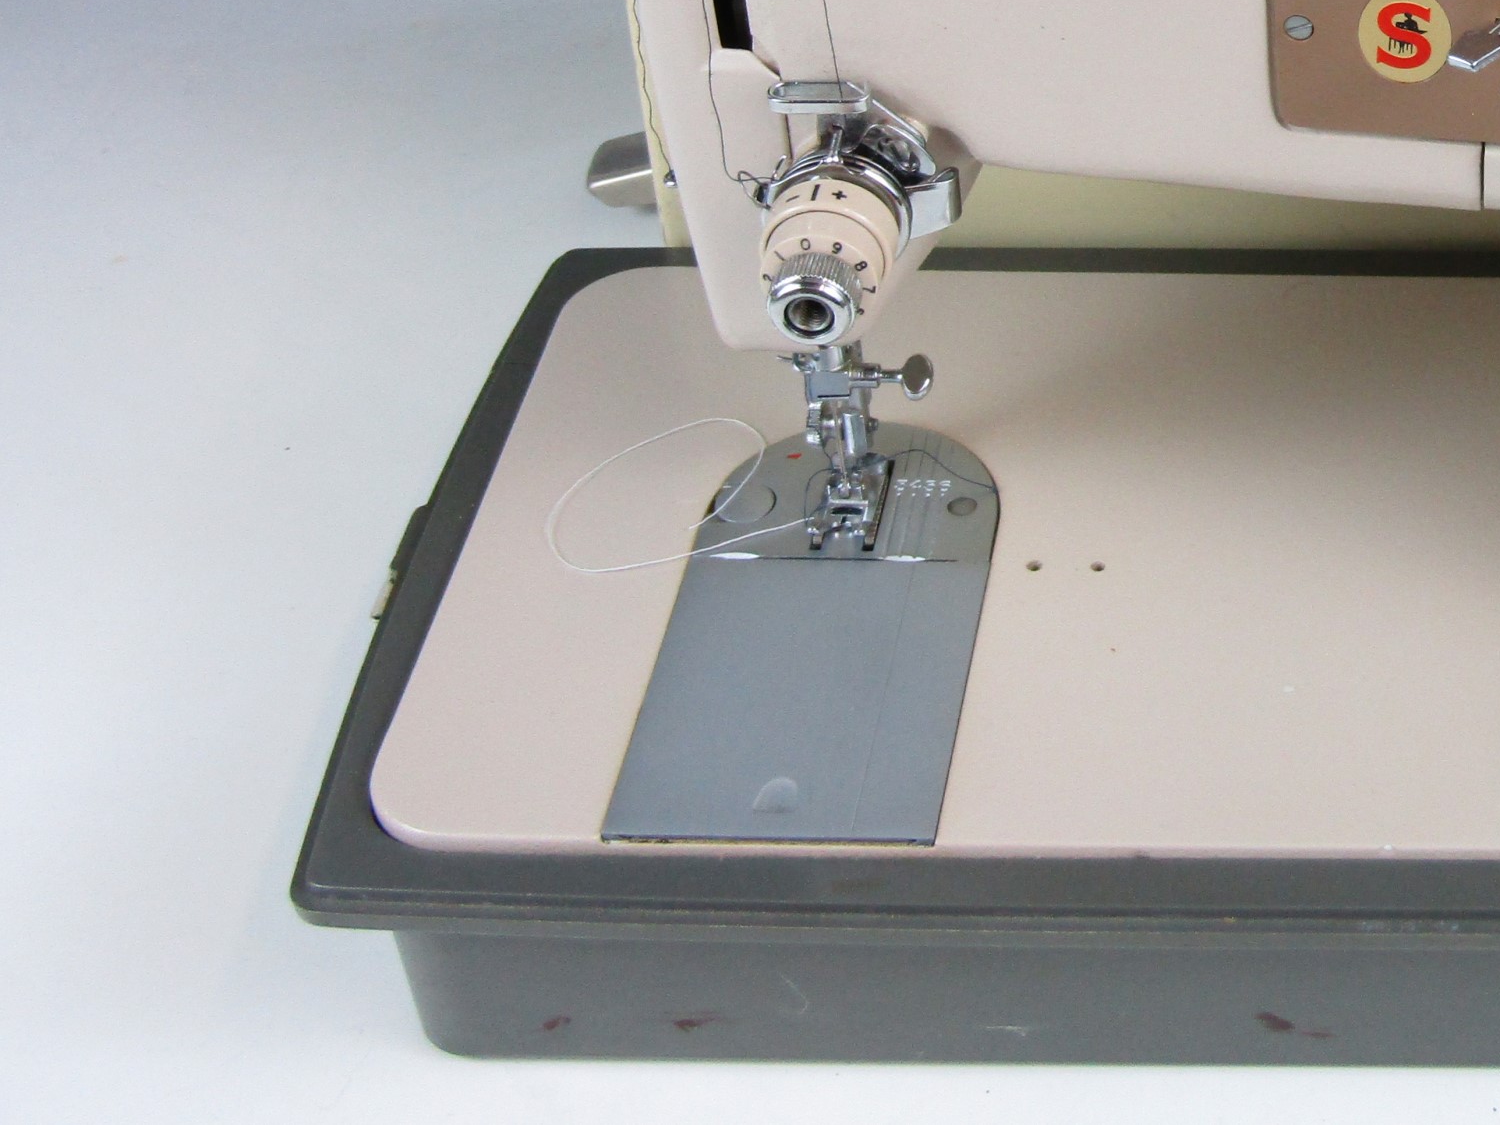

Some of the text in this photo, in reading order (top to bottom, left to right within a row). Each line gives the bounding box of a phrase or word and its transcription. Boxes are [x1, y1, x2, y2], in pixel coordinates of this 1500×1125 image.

[800, 238, 811, 251] 0
[854, 260, 868, 272] 8
[862, 285, 877, 294] 7
